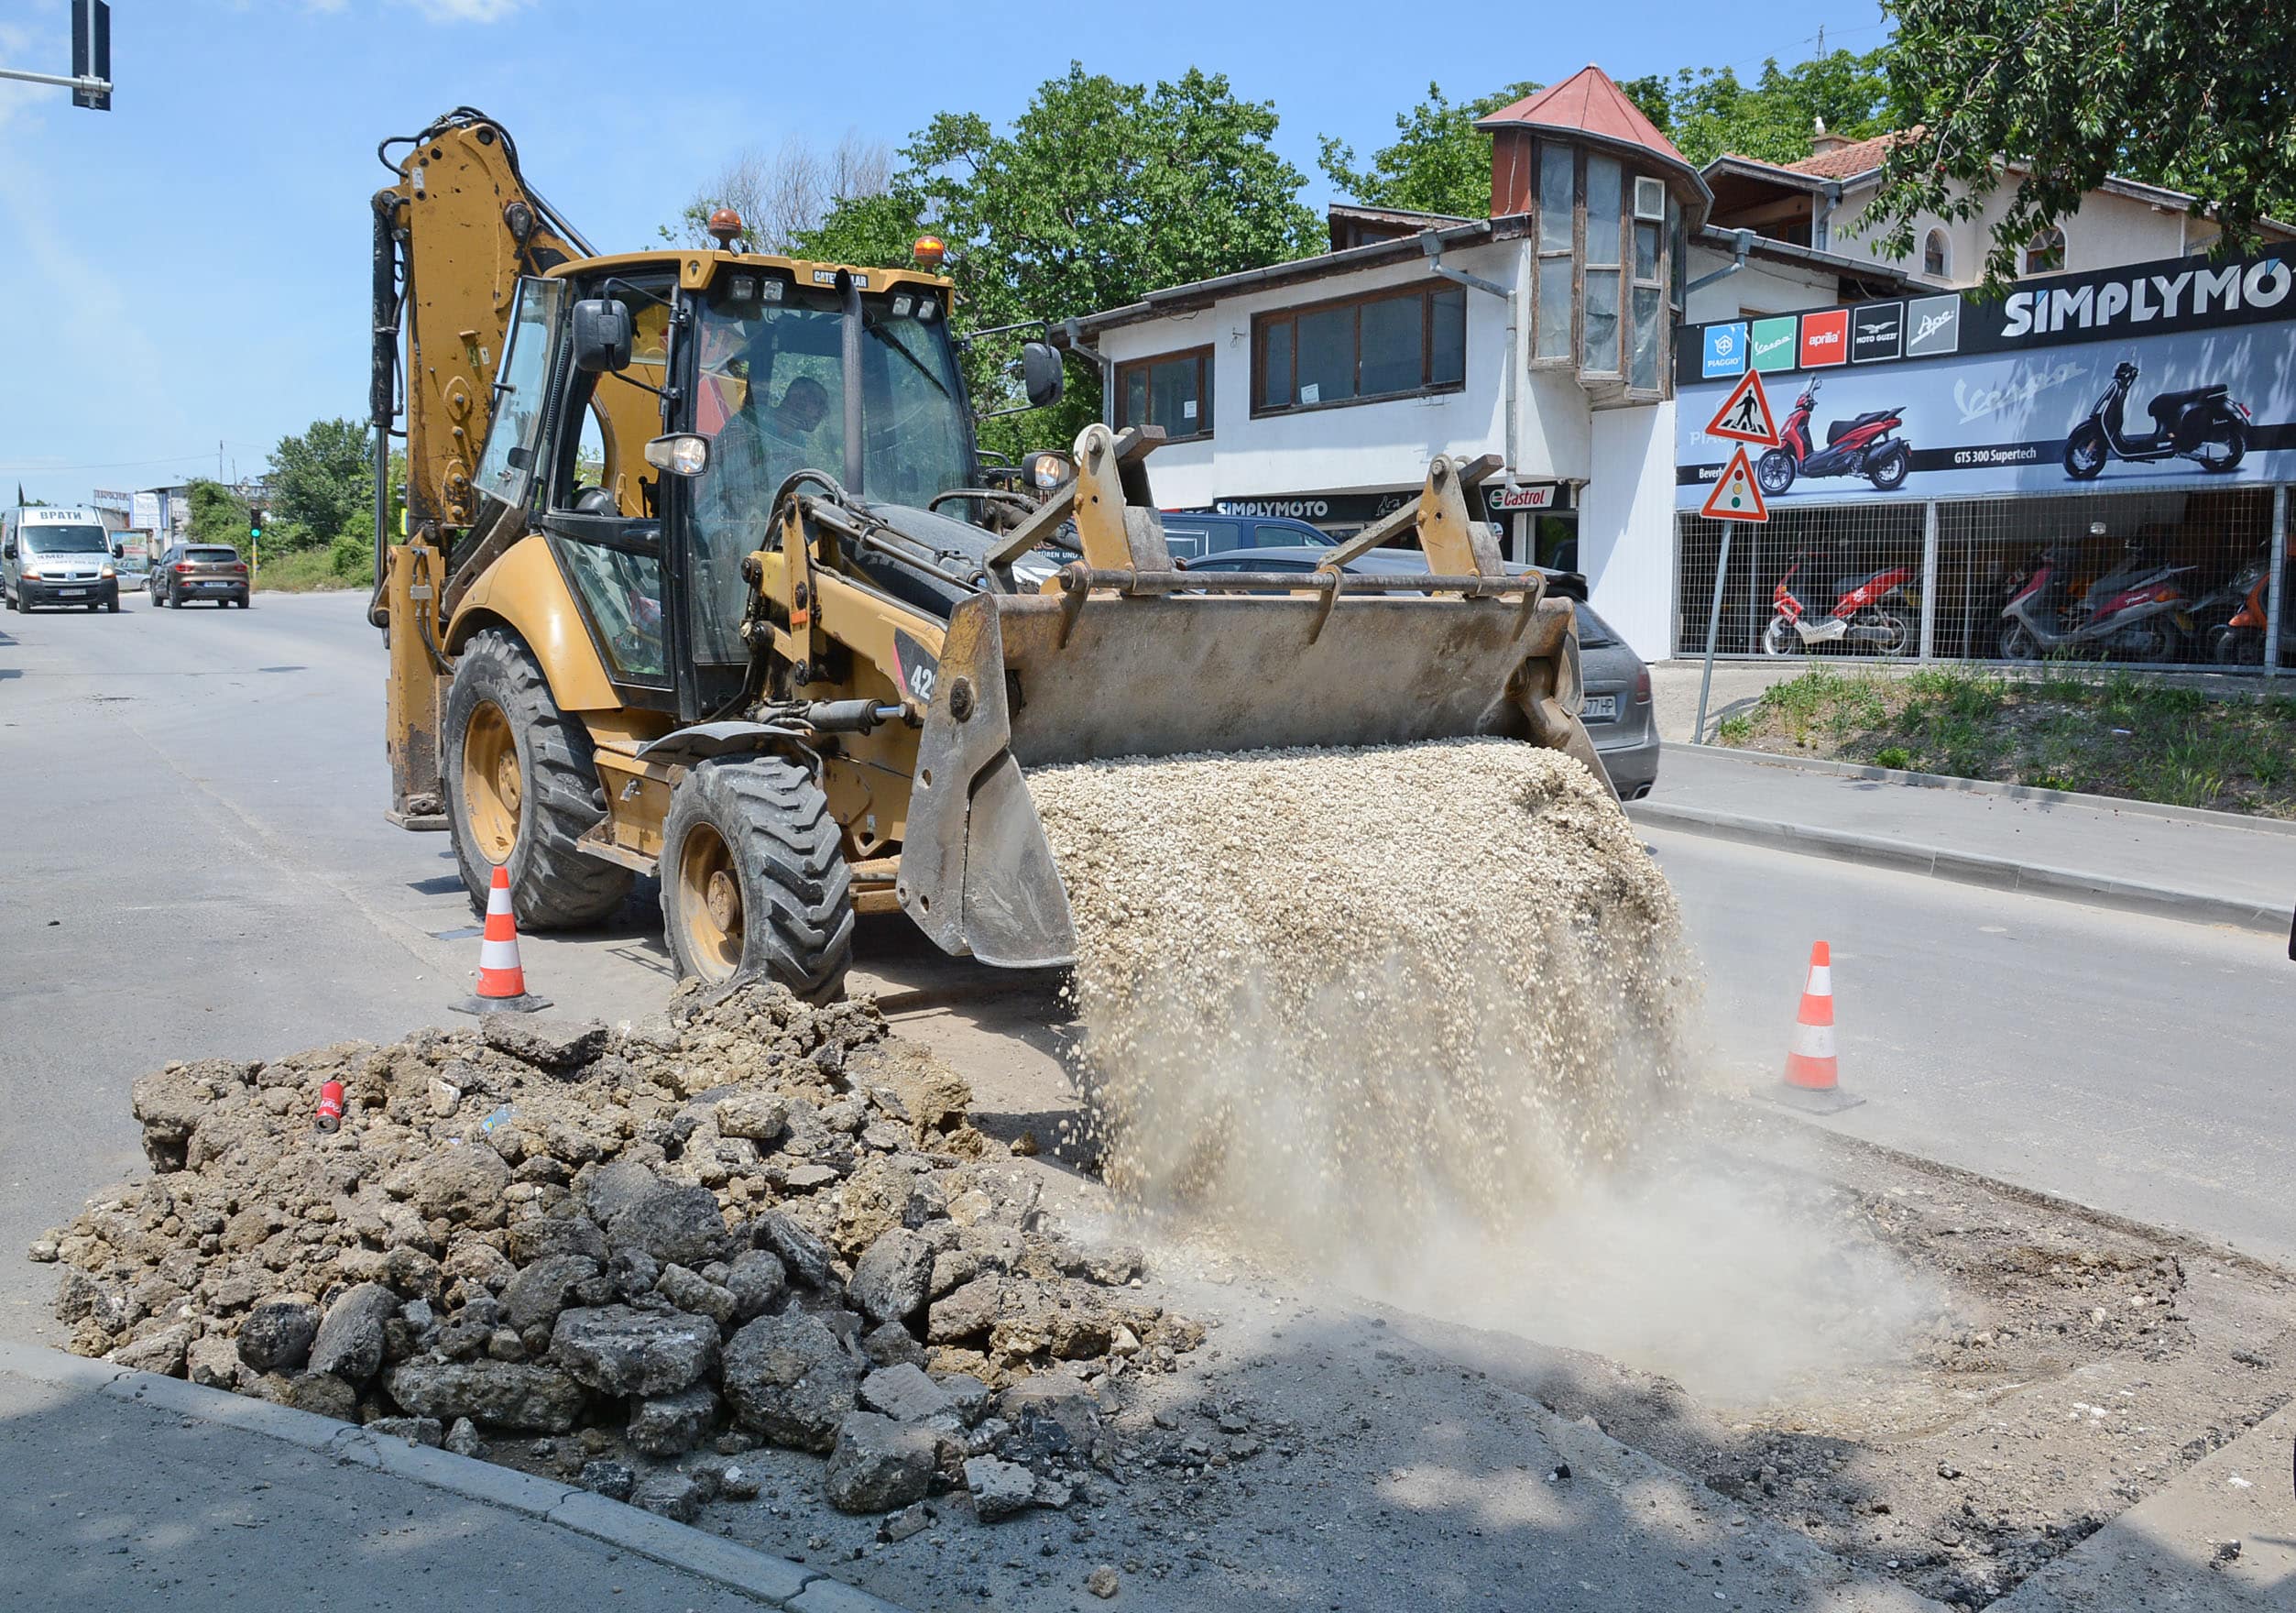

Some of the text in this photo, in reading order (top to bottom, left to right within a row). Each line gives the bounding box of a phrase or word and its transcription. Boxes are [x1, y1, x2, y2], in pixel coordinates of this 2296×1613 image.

[814, 270, 867, 288] CATELAR
[2001, 258, 2296, 337] SIMPLYMO
[1755, 335, 1792, 356] Vespa
[1809, 331, 1839, 346] aprilia
[1856, 332, 1897, 345] MOTO GUZZI
[1707, 357, 1739, 368] PIAGGIO
[1954, 447, 2037, 464] GTS 300 Supertech
[1504, 488, 1546, 507] Castrol
[40, 510, 82, 521] ВРАТИ
[1216, 500, 1328, 517] SIMPLYMOTO
[910, 664, 935, 700] 42
